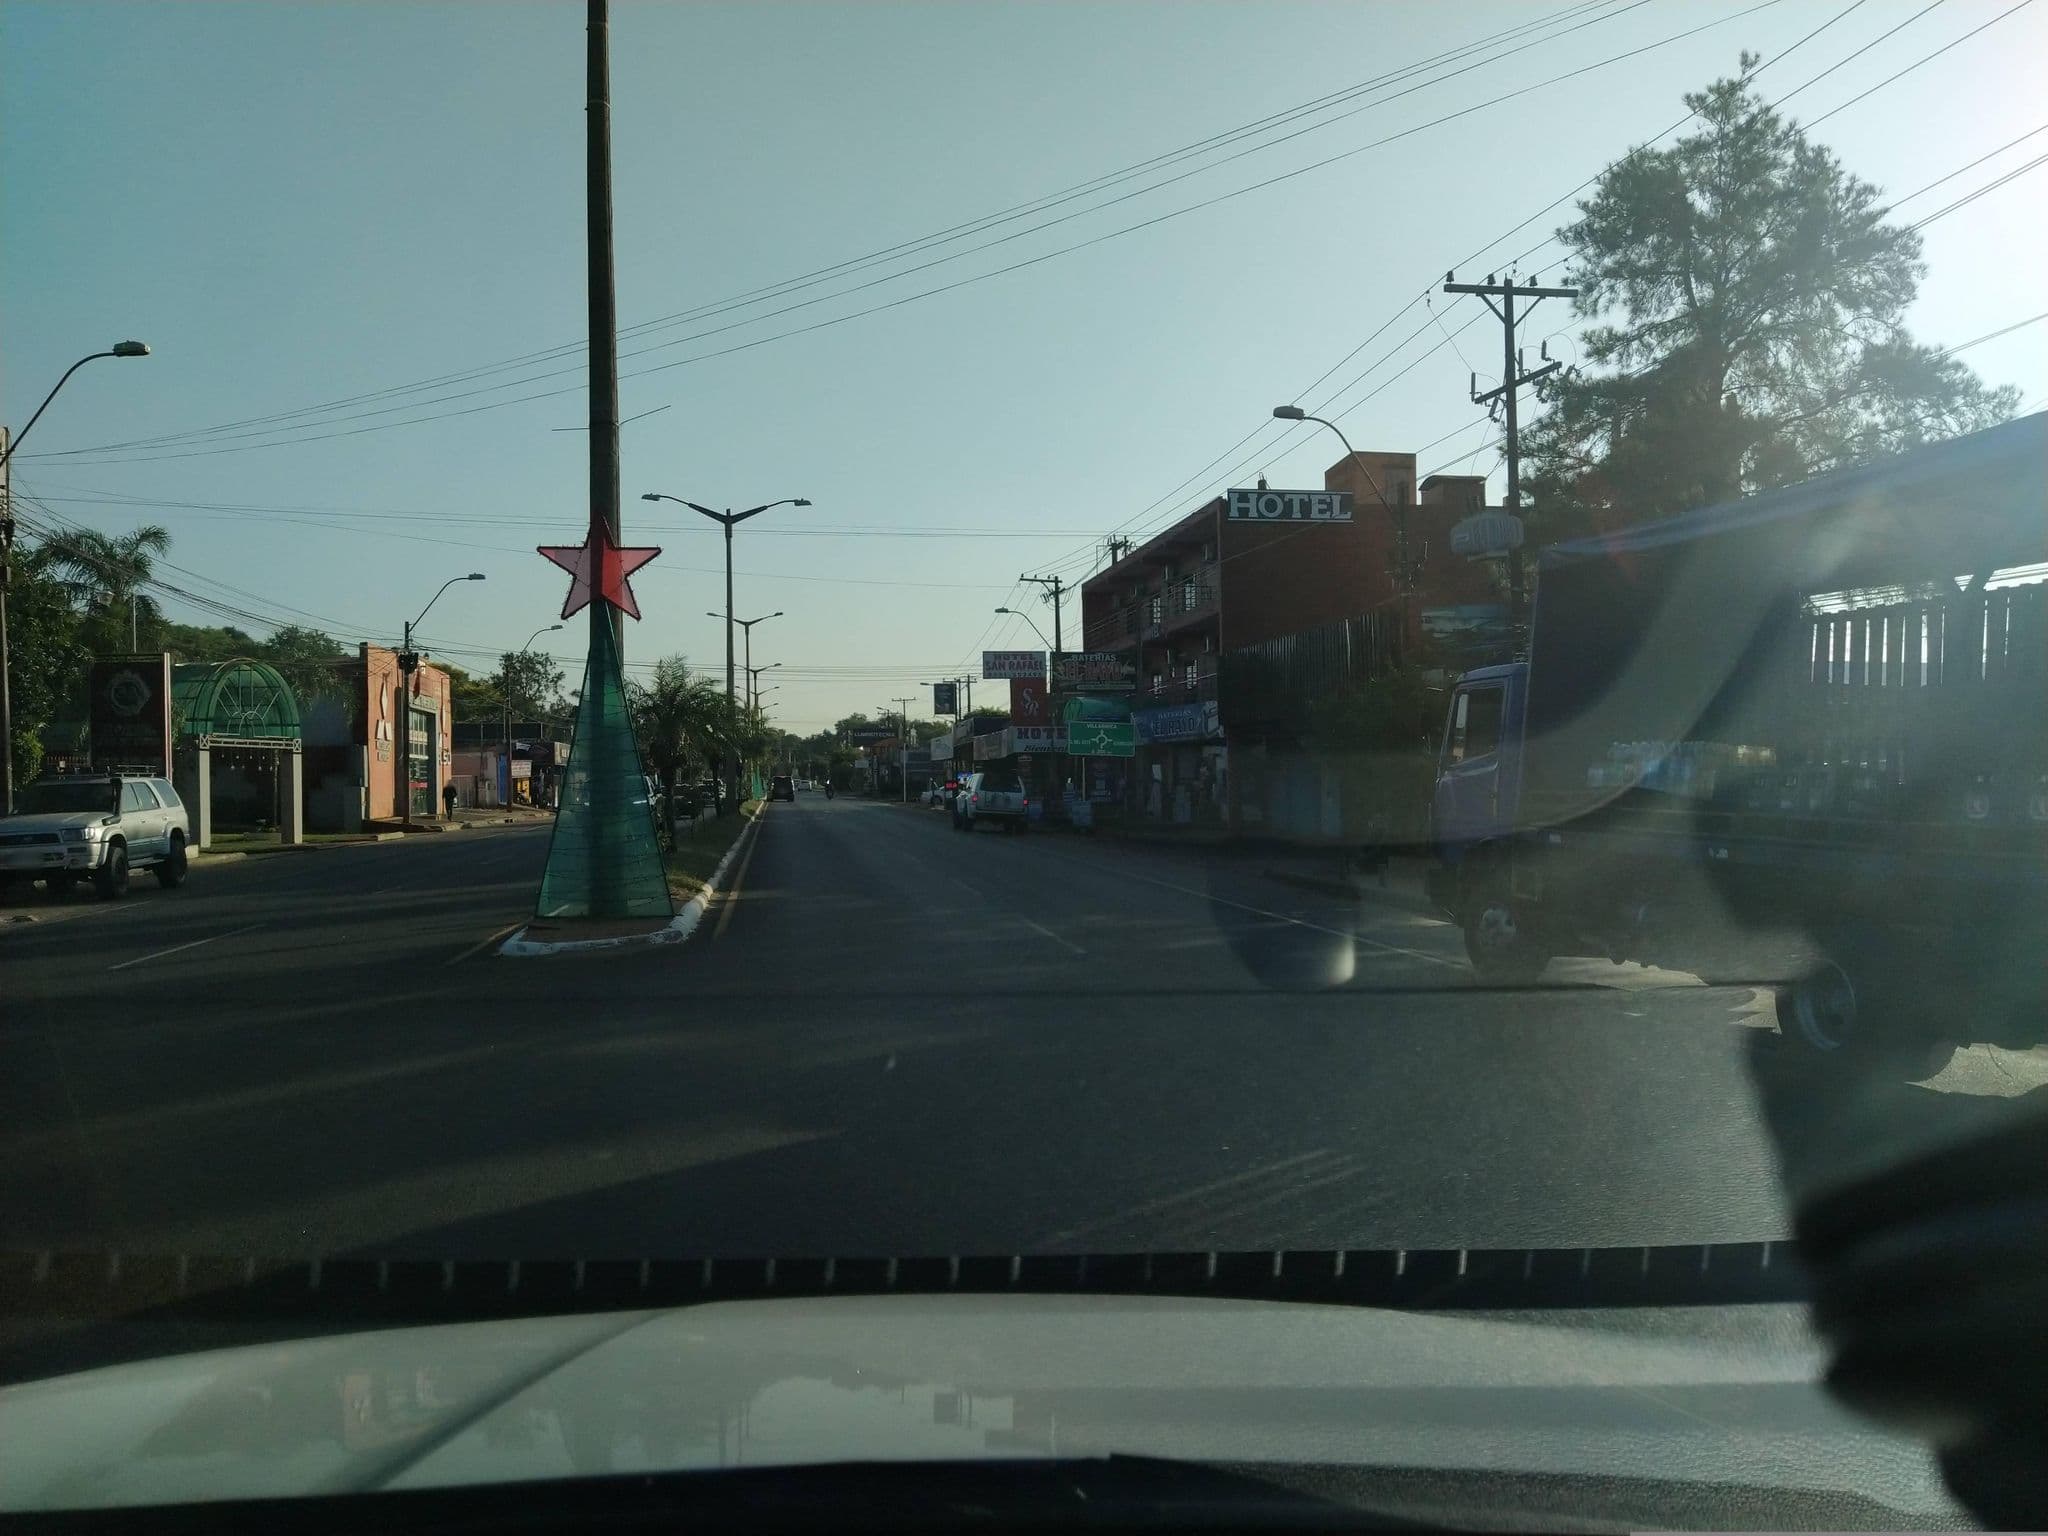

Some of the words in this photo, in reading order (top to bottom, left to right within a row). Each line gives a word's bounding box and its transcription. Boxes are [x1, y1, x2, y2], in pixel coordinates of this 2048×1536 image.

[1228, 493, 1352, 519] HOTEL
[985, 661, 1005, 671] SAN
[1008, 661, 1045, 671] RAFAEL
